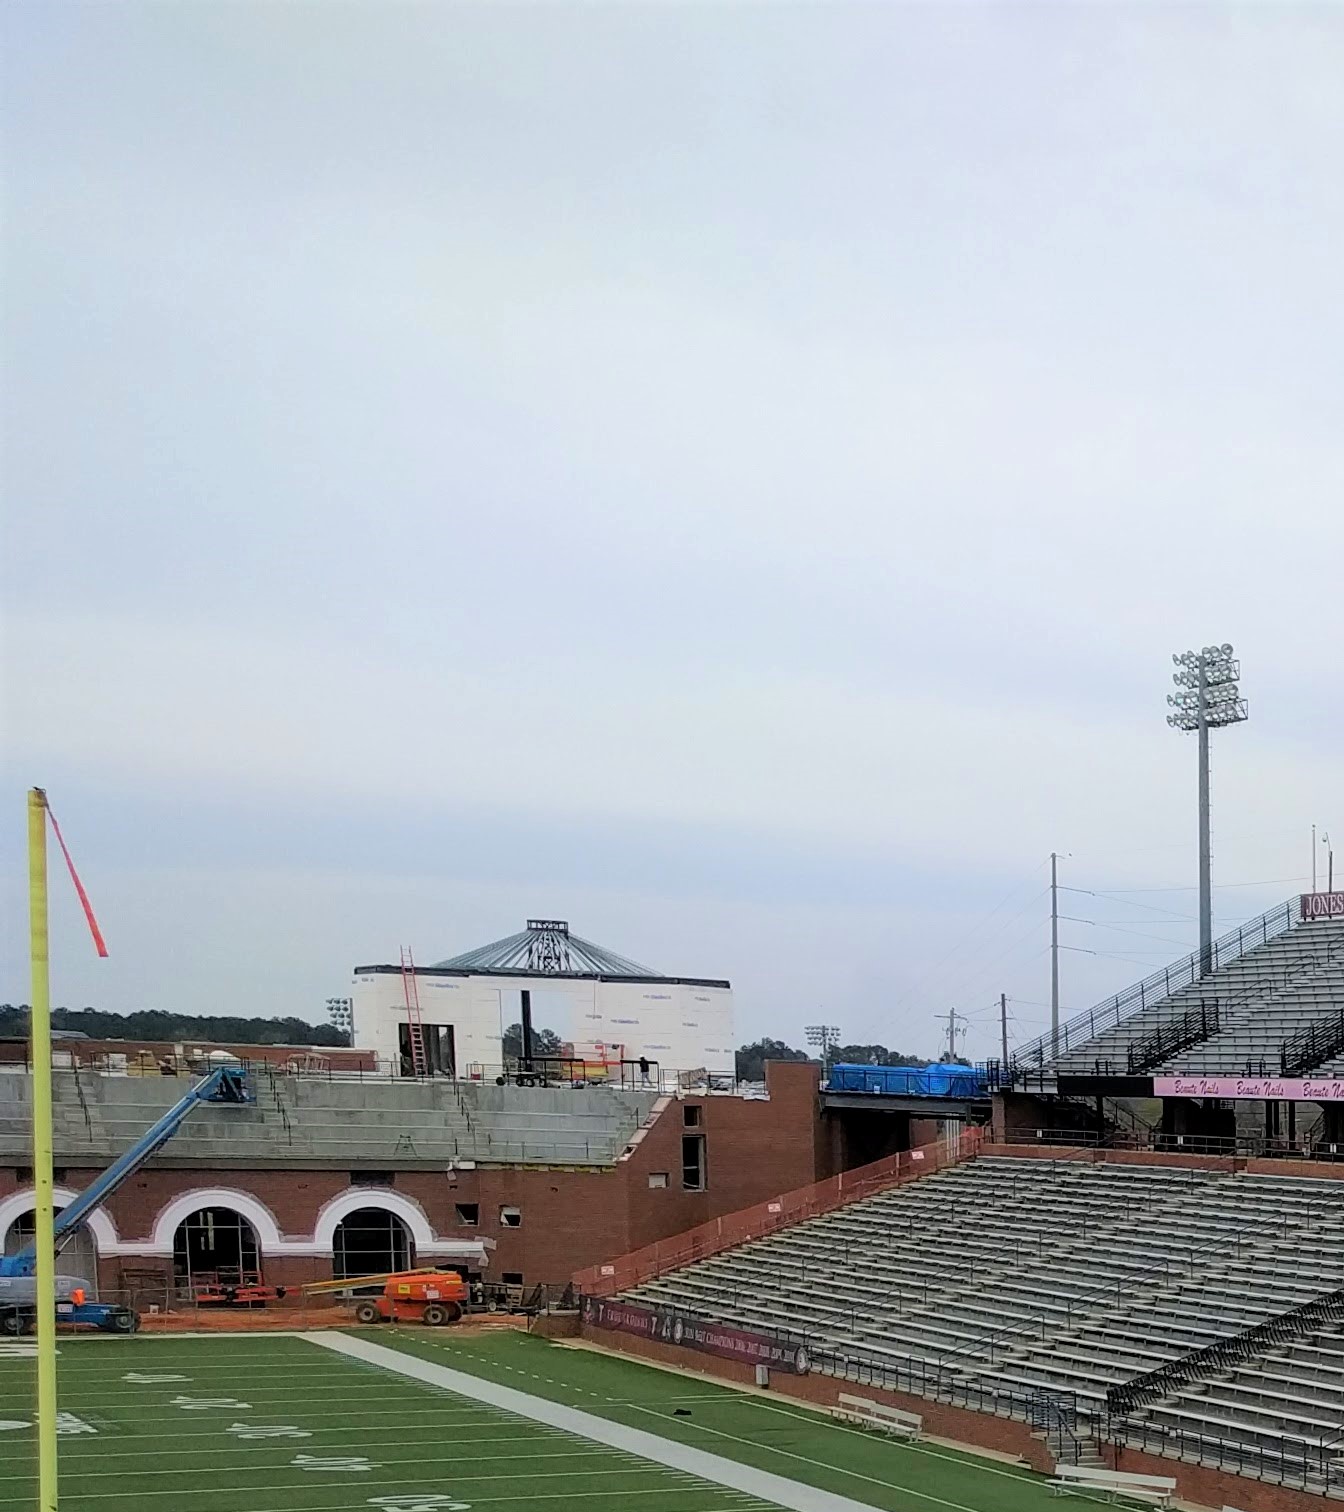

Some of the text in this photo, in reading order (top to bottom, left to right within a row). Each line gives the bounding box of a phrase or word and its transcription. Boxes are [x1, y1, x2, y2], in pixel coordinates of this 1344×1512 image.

[1305, 892, 1344, 916] JONES
[1200, 1080, 1219, 1095] Nails
[1263, 1081, 1284, 1096] Nails
[121, 1374, 194, 1384] 10
[169, 1398, 253, 1410] 20
[225, 1425, 313, 1440] 30
[290, 1457, 382, 1472] 40
[367, 1493, 472, 1512] 50
